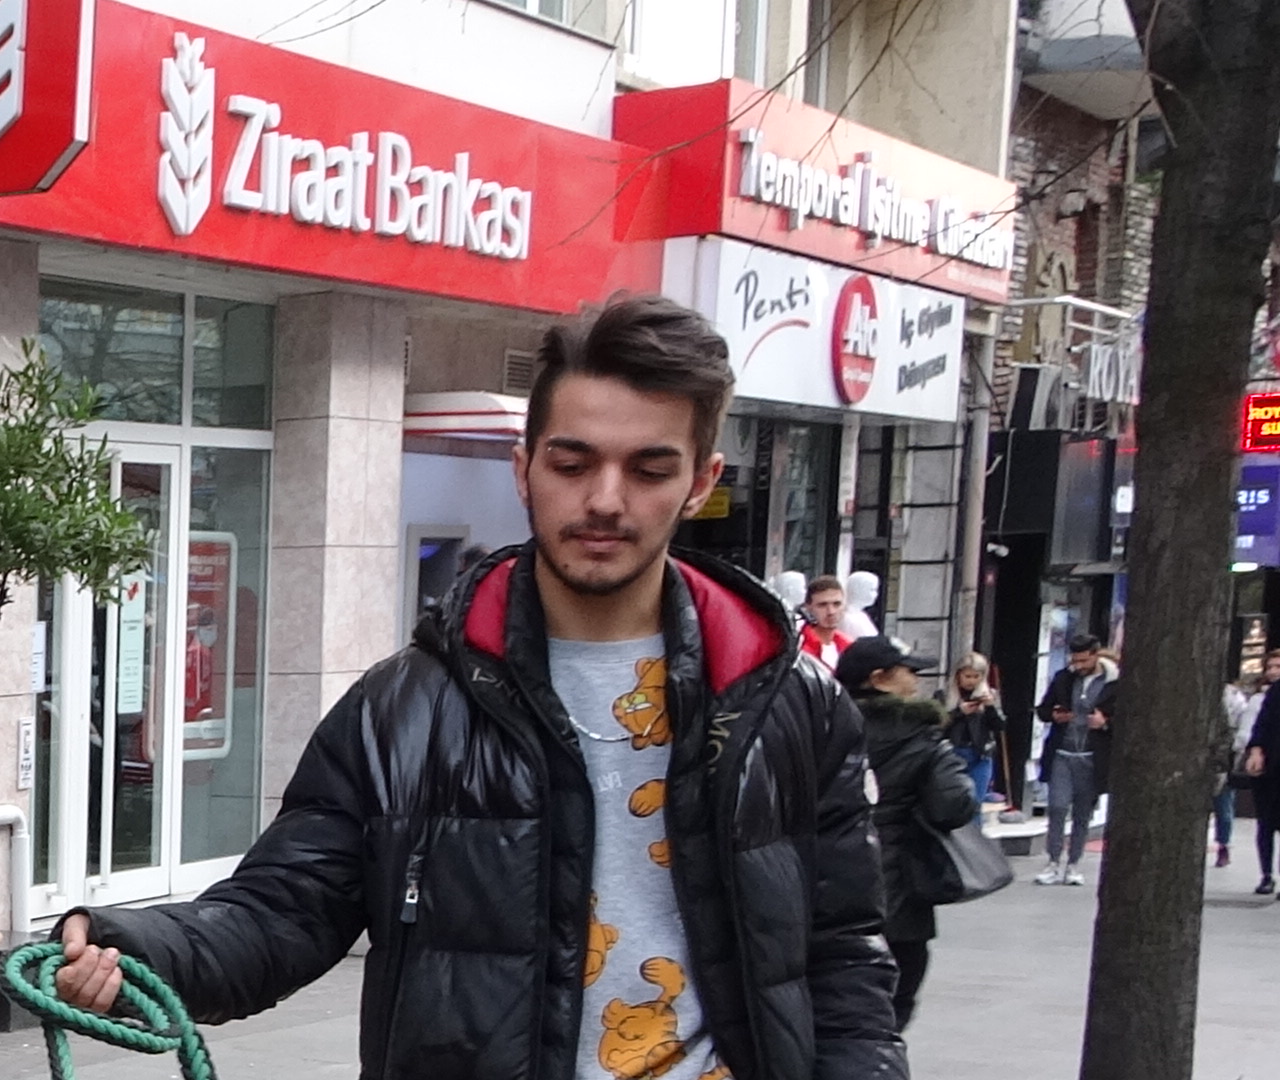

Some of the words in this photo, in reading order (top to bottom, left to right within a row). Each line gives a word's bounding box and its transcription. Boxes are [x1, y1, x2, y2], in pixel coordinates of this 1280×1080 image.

[223, 94, 374, 233] Ziraat
[374, 131, 532, 260] Bankası
[734, 269, 810, 331] Penti
